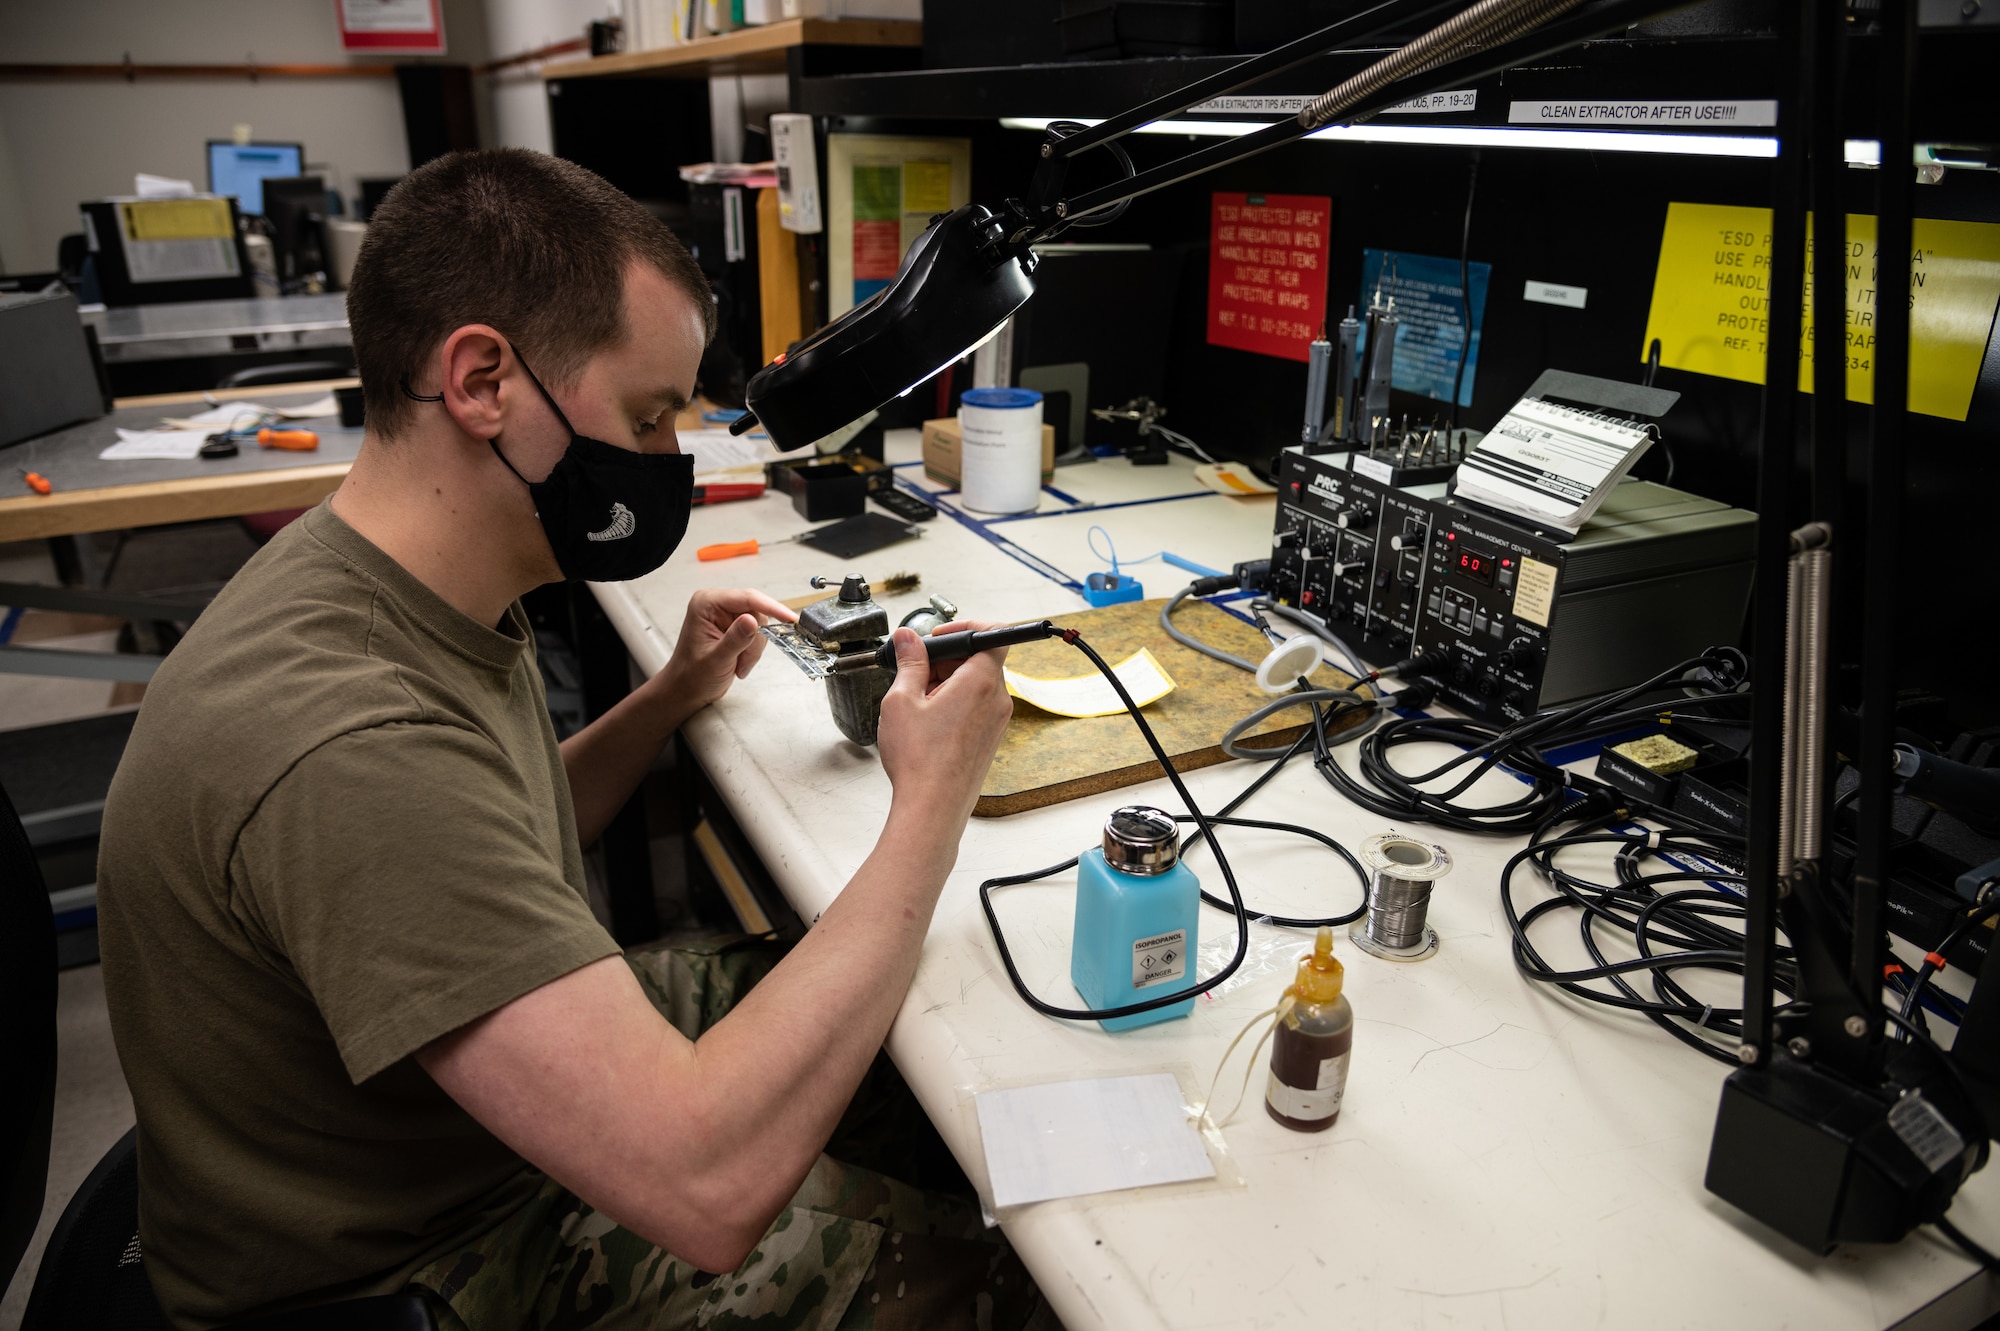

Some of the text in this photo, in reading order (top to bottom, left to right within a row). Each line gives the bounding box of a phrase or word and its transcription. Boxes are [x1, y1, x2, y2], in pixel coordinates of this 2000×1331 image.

[1226, 99, 1262, 109] EXTRACTOR
[1264, 99, 1279, 109] TIPS
[1280, 99, 1301, 109] AFTER
[1432, 96, 1446, 107] PP.
[1541, 105, 1737, 120] CLEAN EXTRACTOR AFTER USE!!!!
[1218, 225, 1235, 242] USE
[1294, 232, 1321, 249] WHEN
[1718, 230, 1755, 247] "ESD
[1714, 250, 1745, 267] USE
[1723, 336, 1750, 351] REF.
[1451, 521, 1532, 556] THERMAL MANAGEMENT CENTER
[1515, 622, 1541, 638] PRESSURE
[1486, 665, 1494, 673] CH
[1611, 763, 1646, 787] Soldering Iron
[1135, 932, 1182, 949] ISOPROPANOL
[1144, 968, 1172, 981] DANGER
